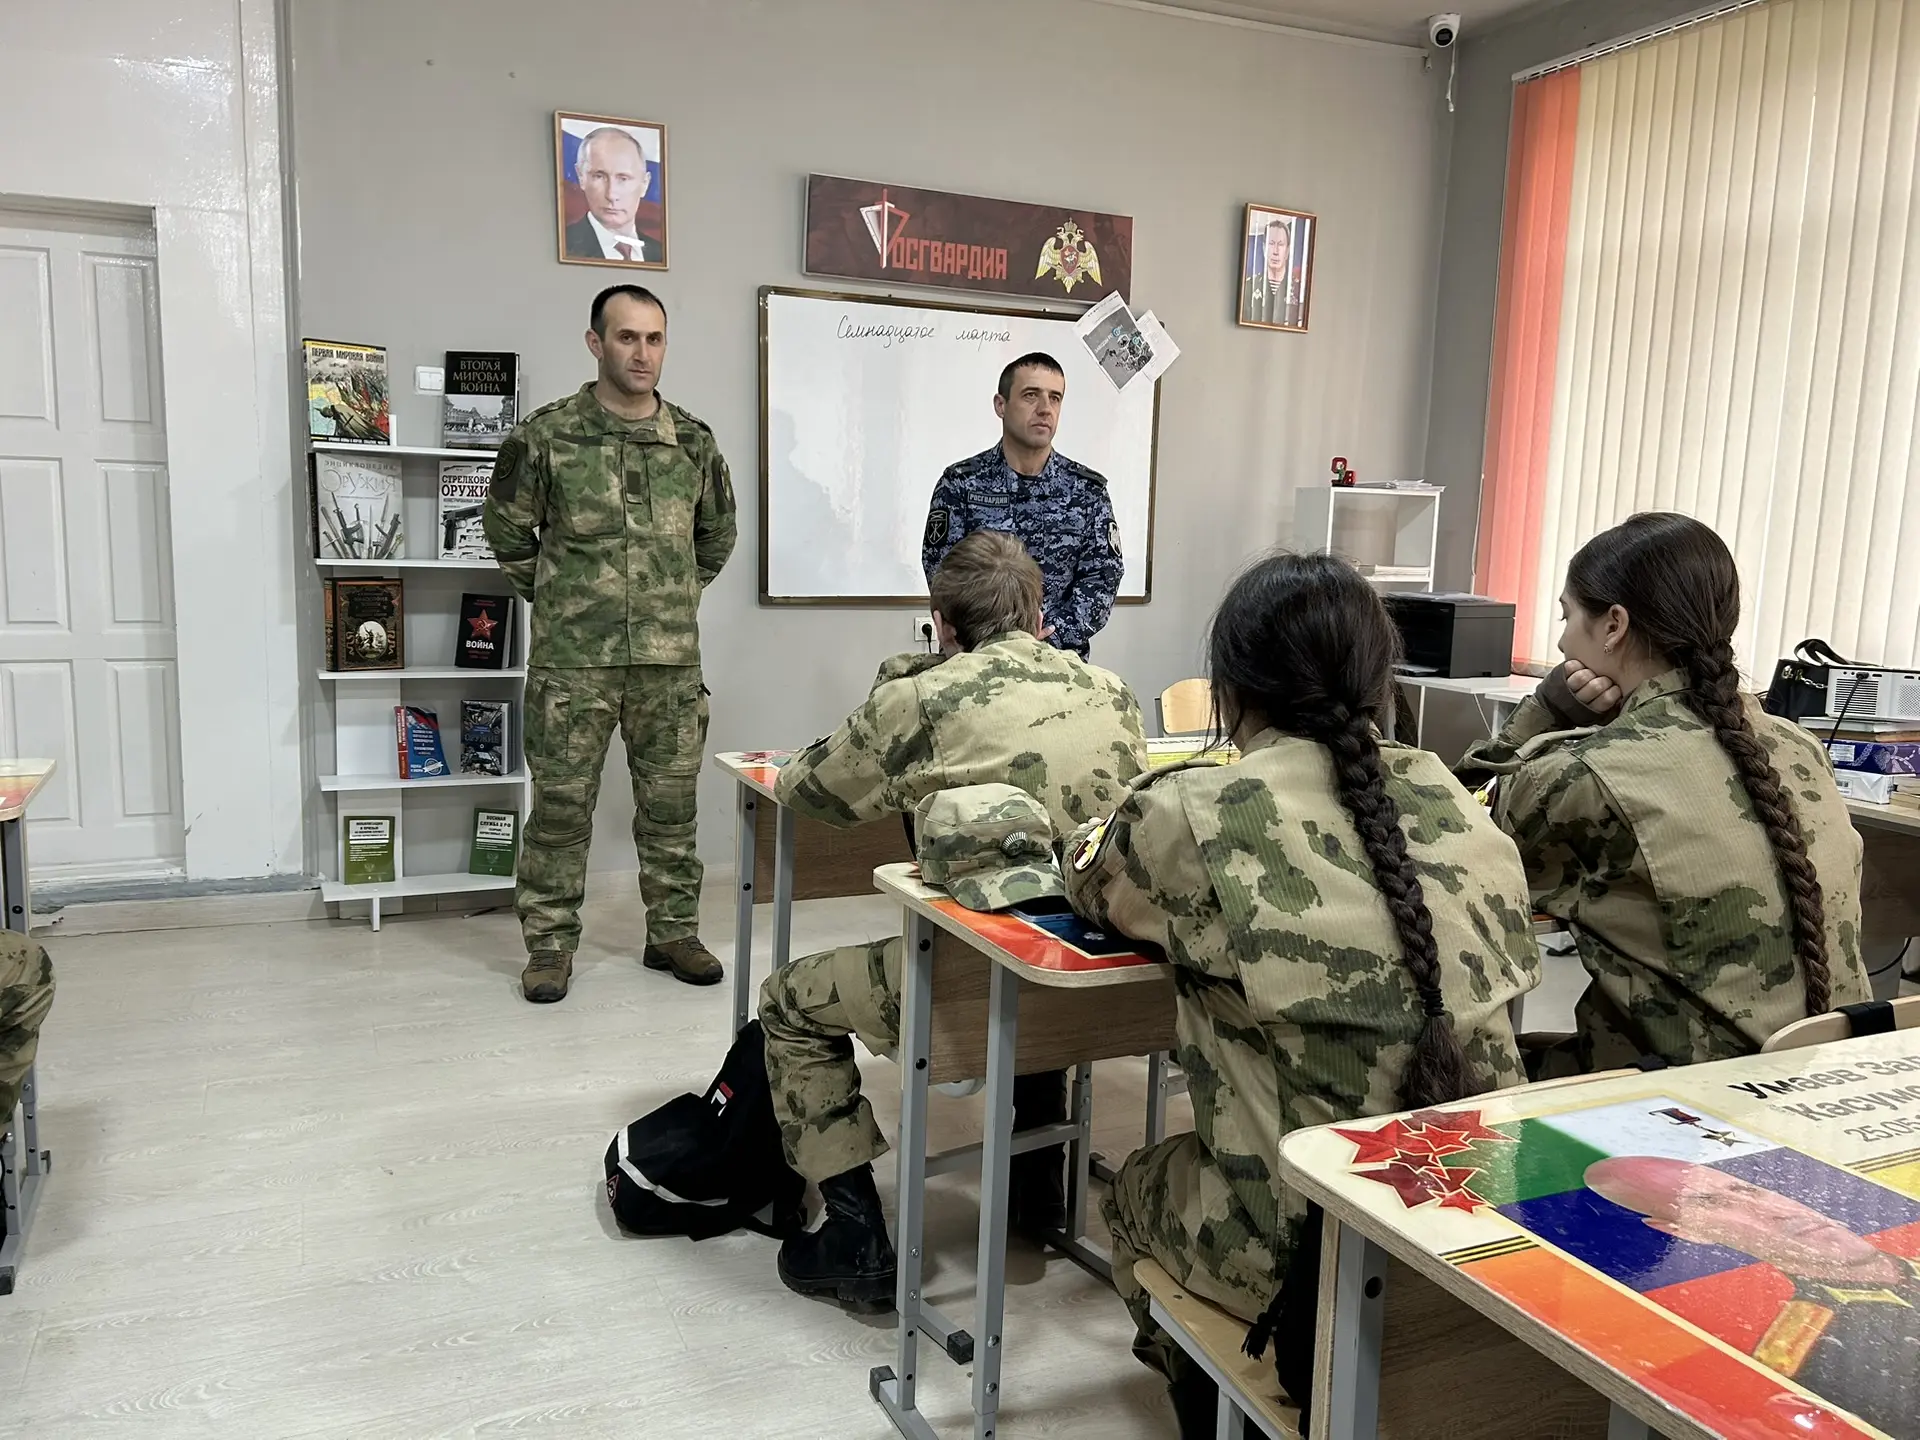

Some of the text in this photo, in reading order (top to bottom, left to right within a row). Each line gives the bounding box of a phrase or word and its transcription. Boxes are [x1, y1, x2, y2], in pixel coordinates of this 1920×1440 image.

[837, 315, 1011, 351] Семнадцатое марта
[312, 348, 384, 363] ПЕРВАЯ МИРОВАЯ ВОЙНА
[461, 360, 500, 370] ВТОРАЯ
[453, 371, 507, 381] МИРОВАЯ
[461, 381, 500, 392] ВОЙНА
[442, 475, 492, 484] СТРЕЛКОВО
[441, 484, 488, 497] ОРУЖИ
[970, 493, 1008, 504] РОСГВАРДИЯ
[465, 640, 494, 650] ВОЙНА
[1727, 1069, 1868, 1099] Умаев
[1844, 1114, 1920, 1142] 25.05
